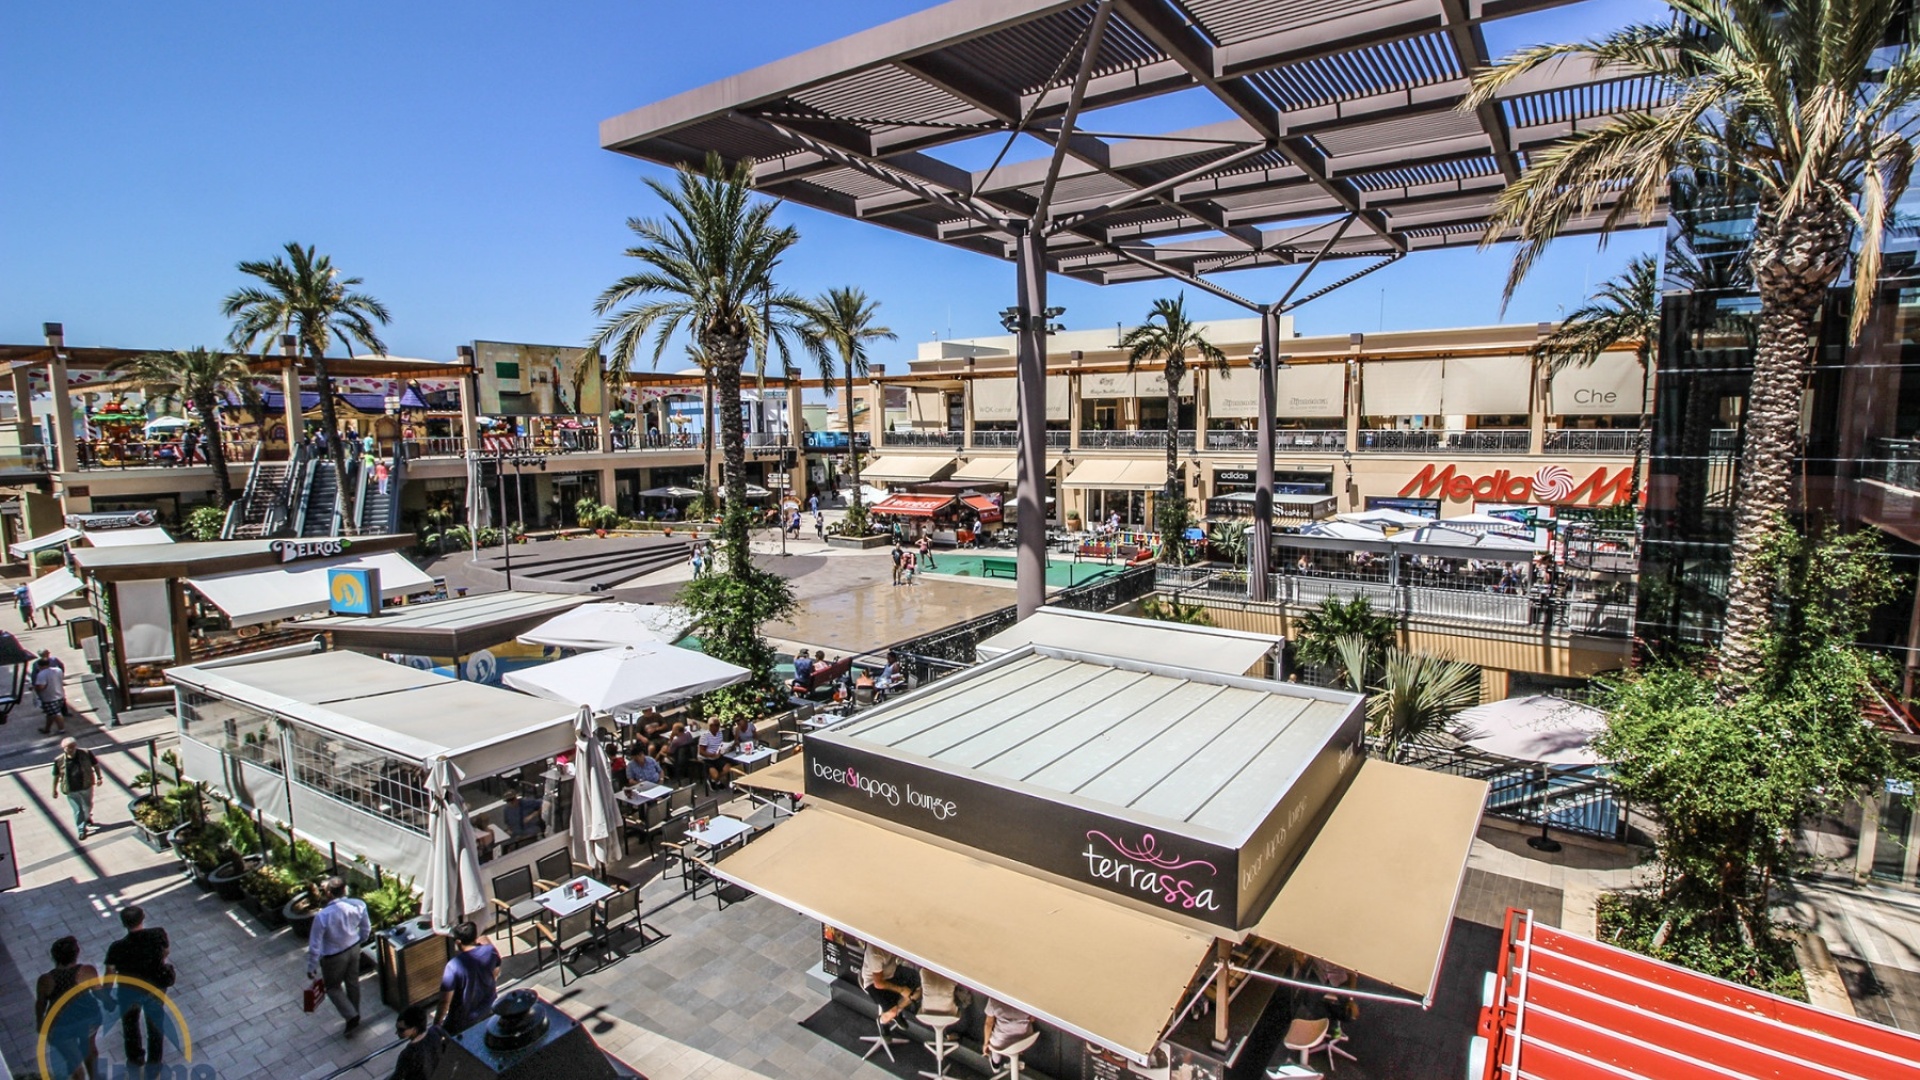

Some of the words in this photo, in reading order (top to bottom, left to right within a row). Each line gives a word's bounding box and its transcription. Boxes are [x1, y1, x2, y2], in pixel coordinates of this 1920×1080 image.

[1574, 389, 1617, 404] Che
[1221, 471, 1249, 480] adidas
[1398, 463, 1534, 501] Media
[271, 540, 342, 562] BELROS
[906, 784, 957, 820] lounge
[1082, 843, 1220, 911] terrassa
